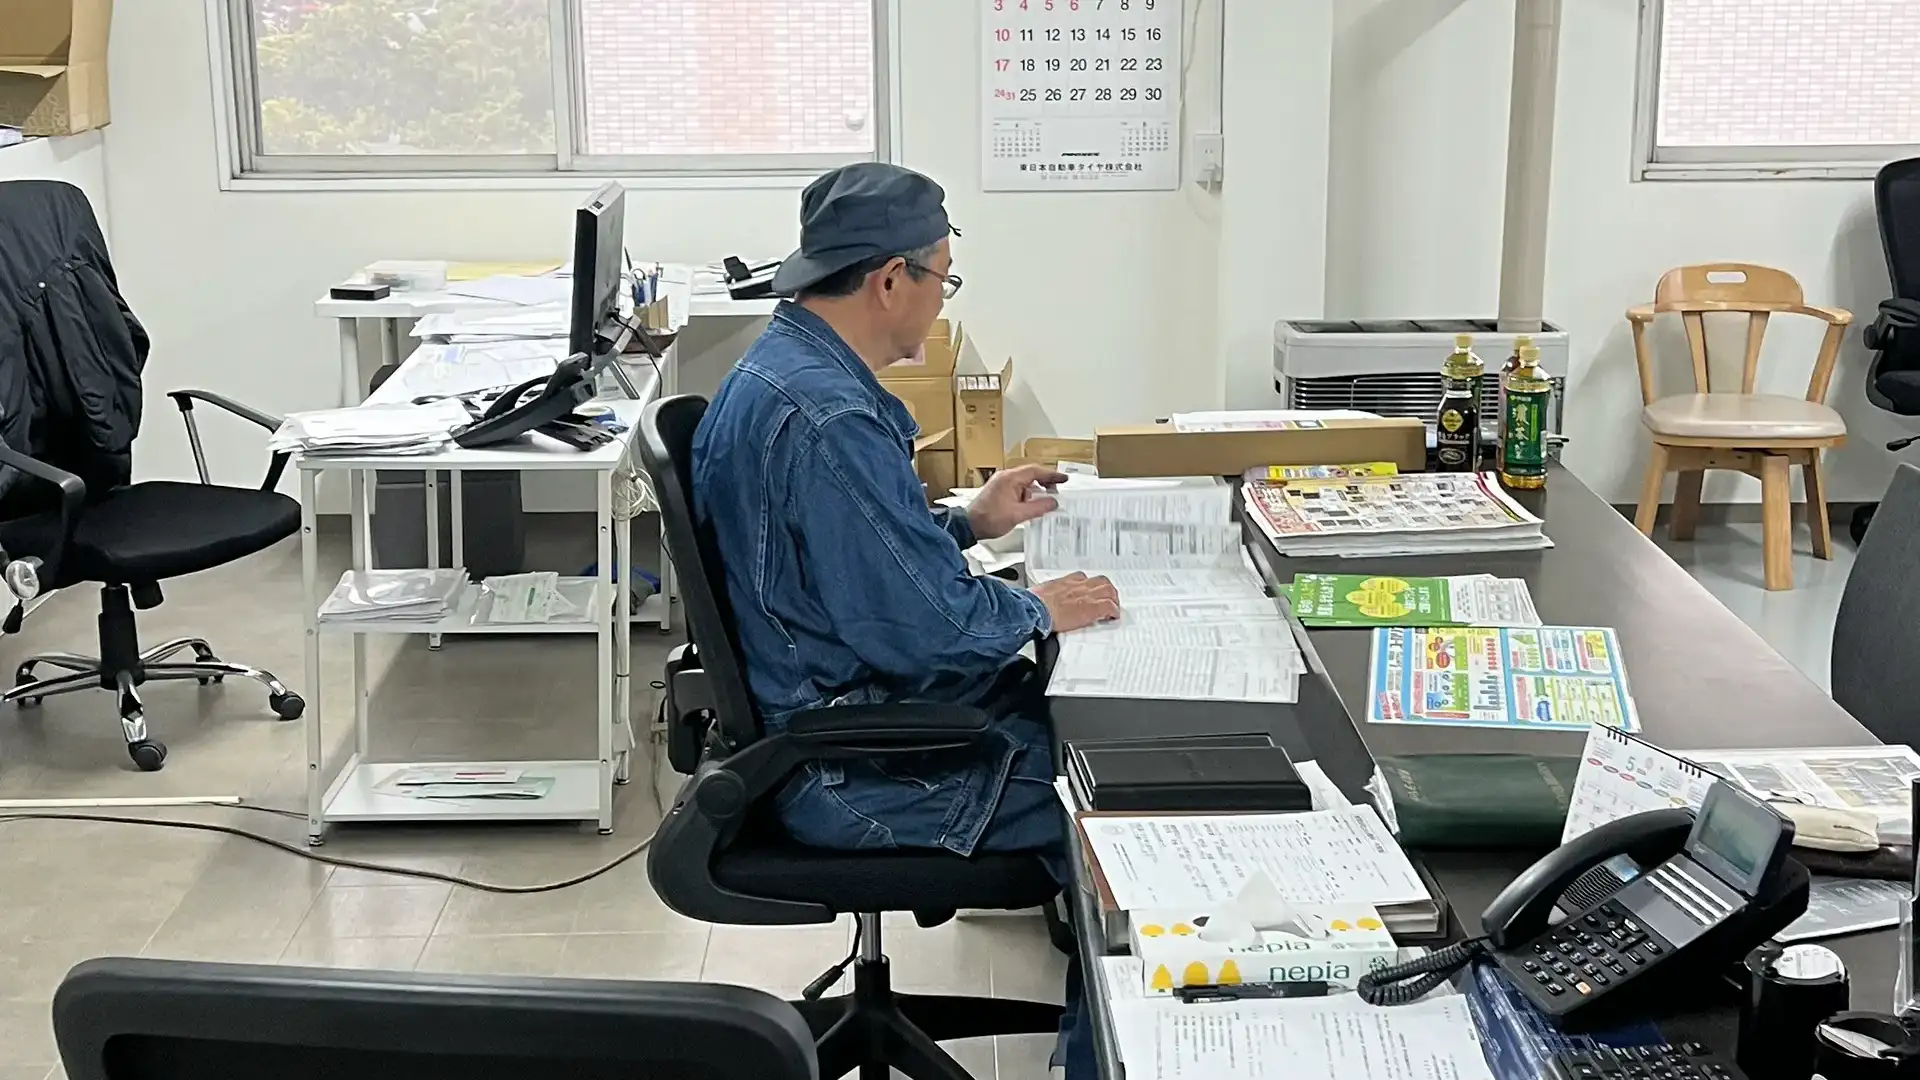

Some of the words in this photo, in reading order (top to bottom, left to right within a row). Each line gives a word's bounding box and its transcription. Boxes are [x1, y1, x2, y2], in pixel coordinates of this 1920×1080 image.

[994, 0, 1003, 11] 3
[1019, 0, 1028, 11] 4
[1045, 0, 1054, 11] 5
[1070, 0, 1079, 11] 6
[1095, 0, 1103, 11] 7
[1120, 0, 1130, 11] 8
[1146, 0, 1155, 11] 9
[995, 29, 1010, 42] 10
[1020, 29, 1033, 41] 11
[1045, 28, 1060, 41] 12
[1070, 28, 1086, 41] 13
[1096, 28, 1110, 41] 14
[1121, 28, 1136, 41] 15
[1146, 28, 1161, 41] 16
[995, 59, 1010, 72] 17
[1020, 59, 1035, 71] 18
[1045, 59, 1060, 71] 19
[1070, 59, 1087, 71] 20
[1095, 59, 1109, 71] 21
[1120, 58, 1137, 71] 22
[1145, 58, 1162, 71] 23
[1020, 89, 1036, 101] 25
[1045, 89, 1061, 101] 26
[1070, 89, 1086, 101] 27
[1095, 88, 1112, 101] 28
[1120, 88, 1137, 101] 29
[1145, 88, 1162, 101] 30
[1020, 163, 1143, 171] 東日本自動車タイヤ株式会社
[1269, 961, 1350, 983] nepia
